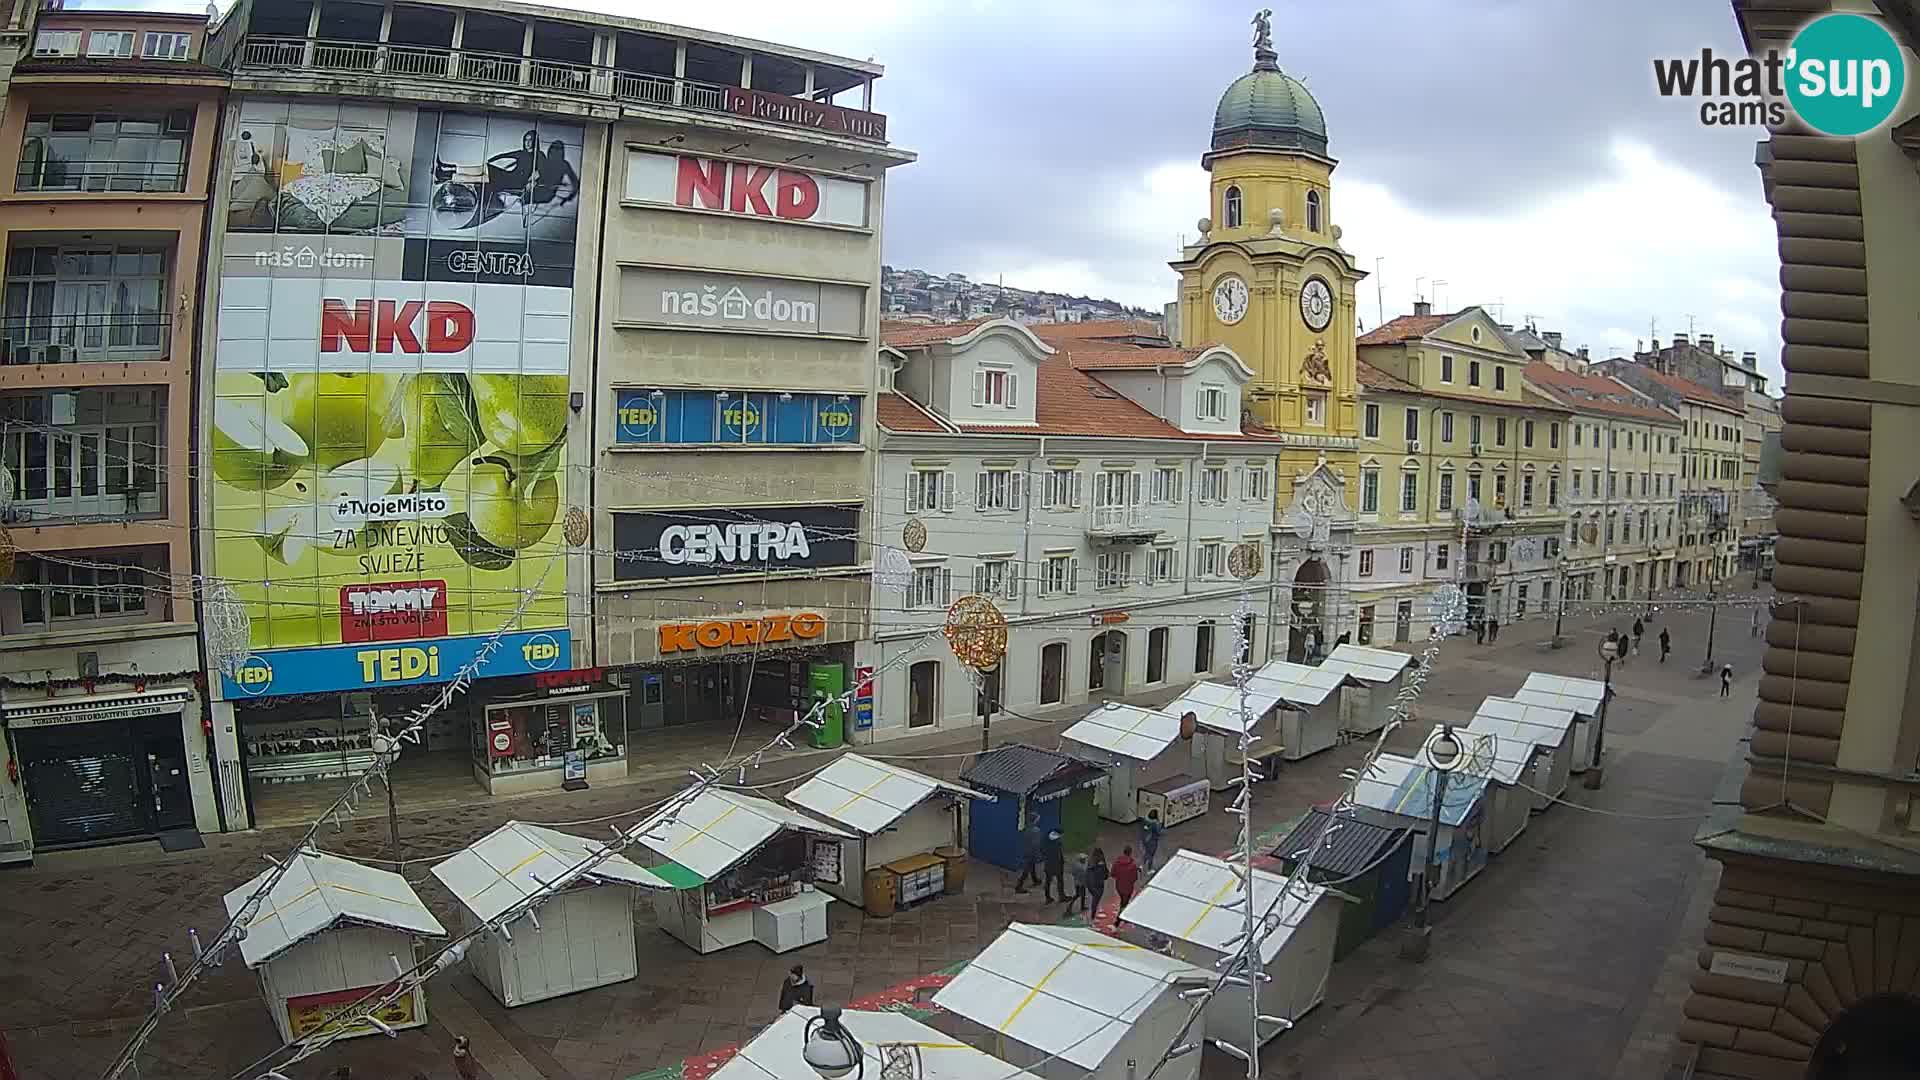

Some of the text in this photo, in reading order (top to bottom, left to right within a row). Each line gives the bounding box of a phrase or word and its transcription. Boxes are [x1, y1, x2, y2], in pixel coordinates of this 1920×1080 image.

[674, 157, 820, 220] NKD
[255, 246, 365, 269] naš dom
[447, 250, 534, 277] CENTRA
[661, 284, 817, 324] naš dom
[320, 297, 477, 354] NKD
[618, 408, 657, 426] TEDi
[723, 408, 760, 427] TEDi
[819, 411, 853, 428] TEDi
[338, 497, 446, 516] #TvojeMisto
[333, 524, 450, 549] ZA DNEVNO
[659, 521, 811, 565] CENTRA
[359, 547, 426, 575] SVJEŽE
[348, 587, 440, 615] TOMMY
[660, 612, 826, 654] KORZO
[357, 646, 440, 683] TEDi
[522, 644, 560, 661] TEDi
